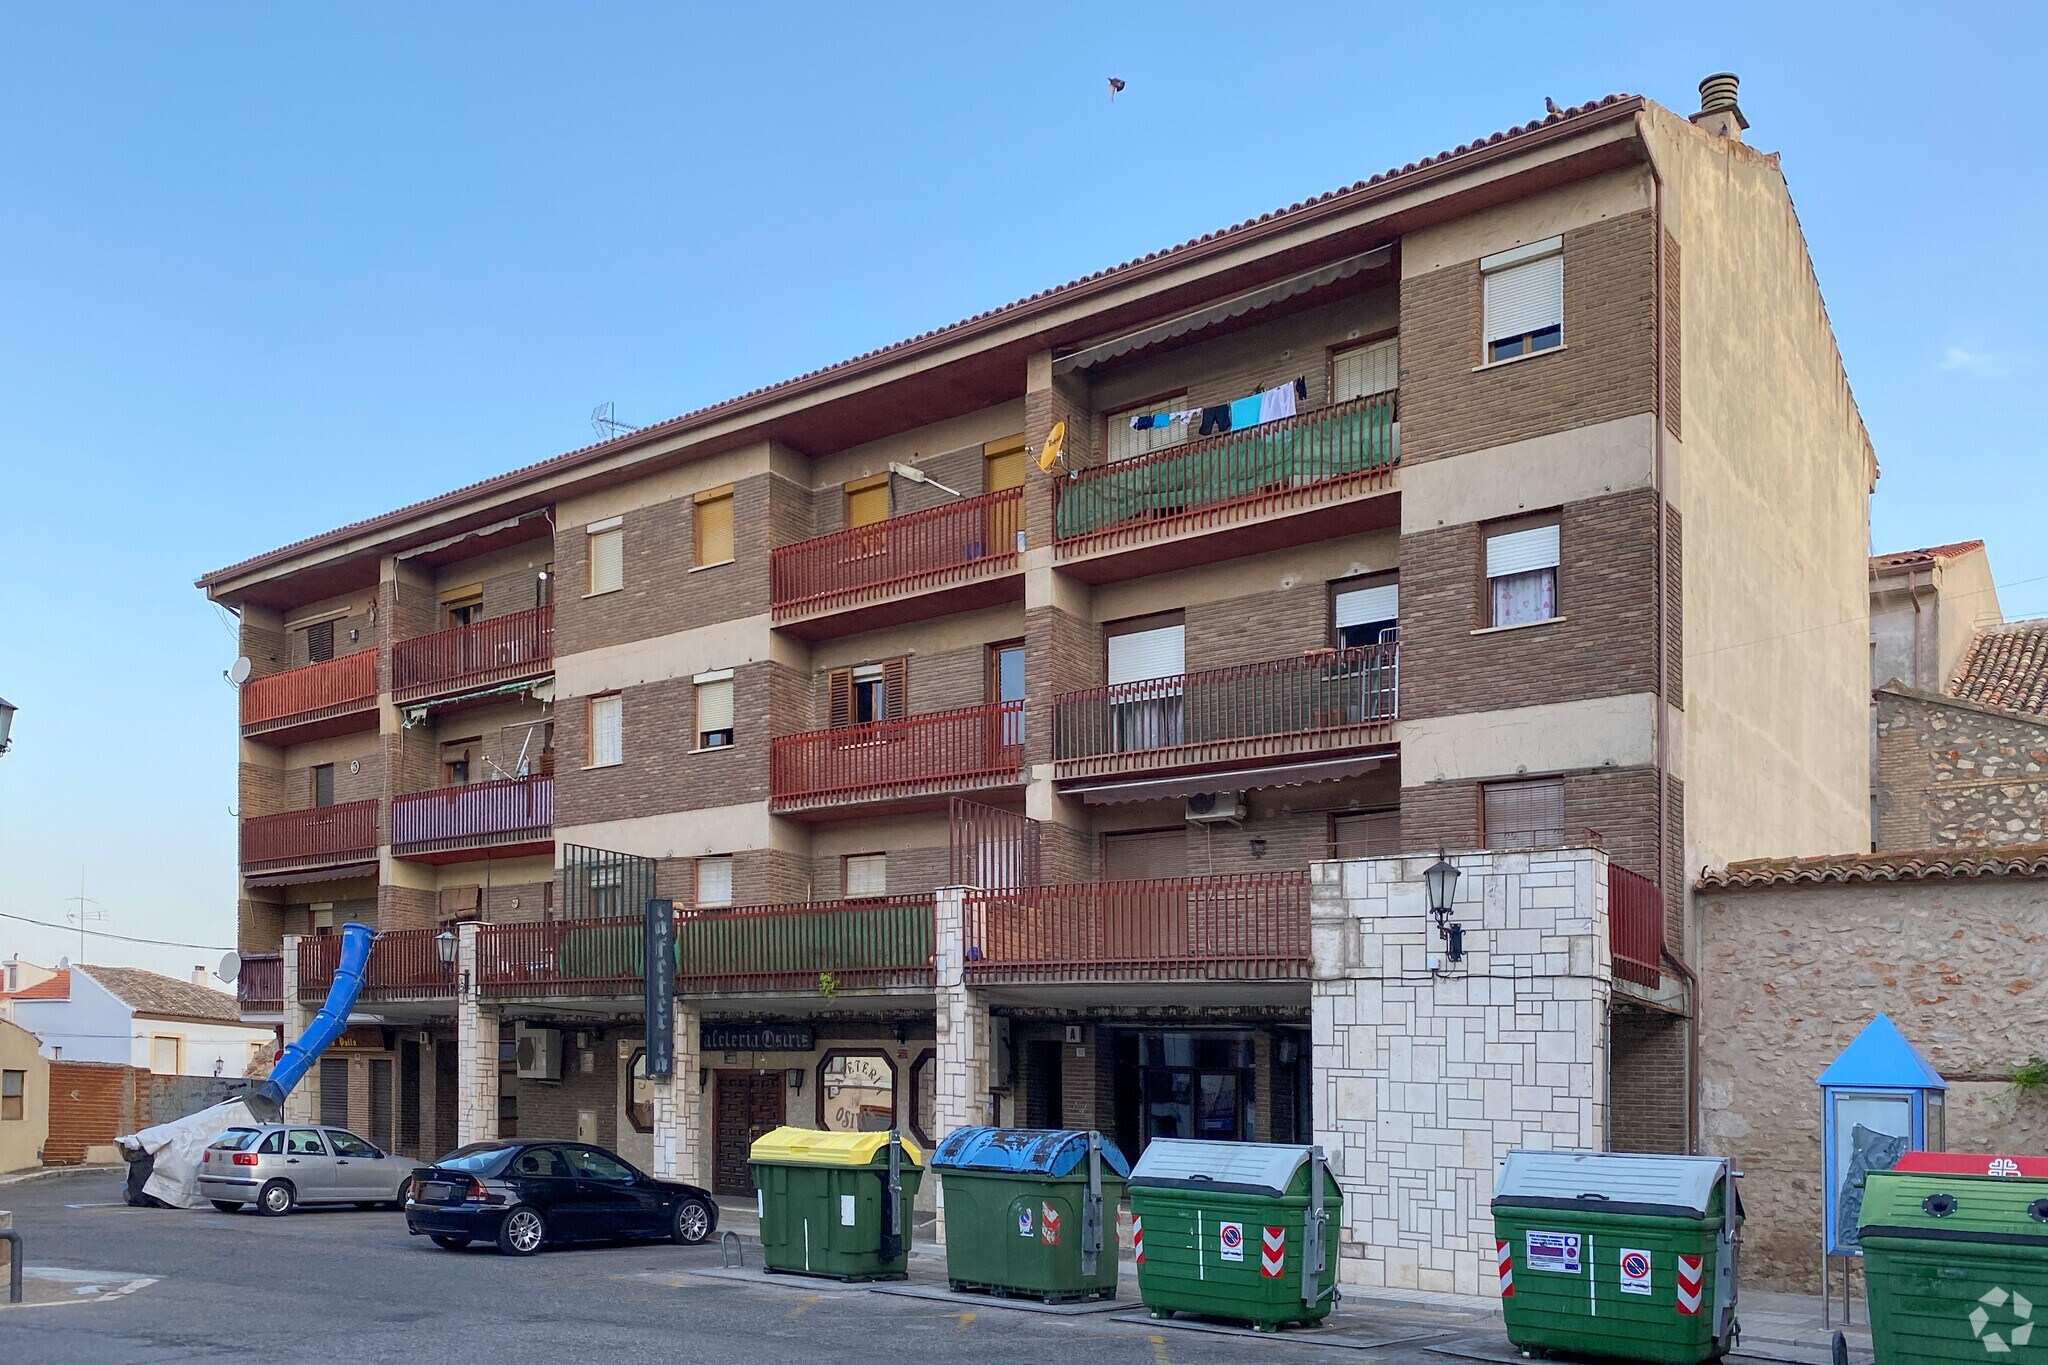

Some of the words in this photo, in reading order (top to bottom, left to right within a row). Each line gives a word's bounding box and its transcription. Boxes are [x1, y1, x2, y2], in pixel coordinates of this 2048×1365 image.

[700, 1028, 760, 1049] afeteria
[761, 1029, 809, 1049] Osiris
[1070, 1027, 1075, 1040] A
